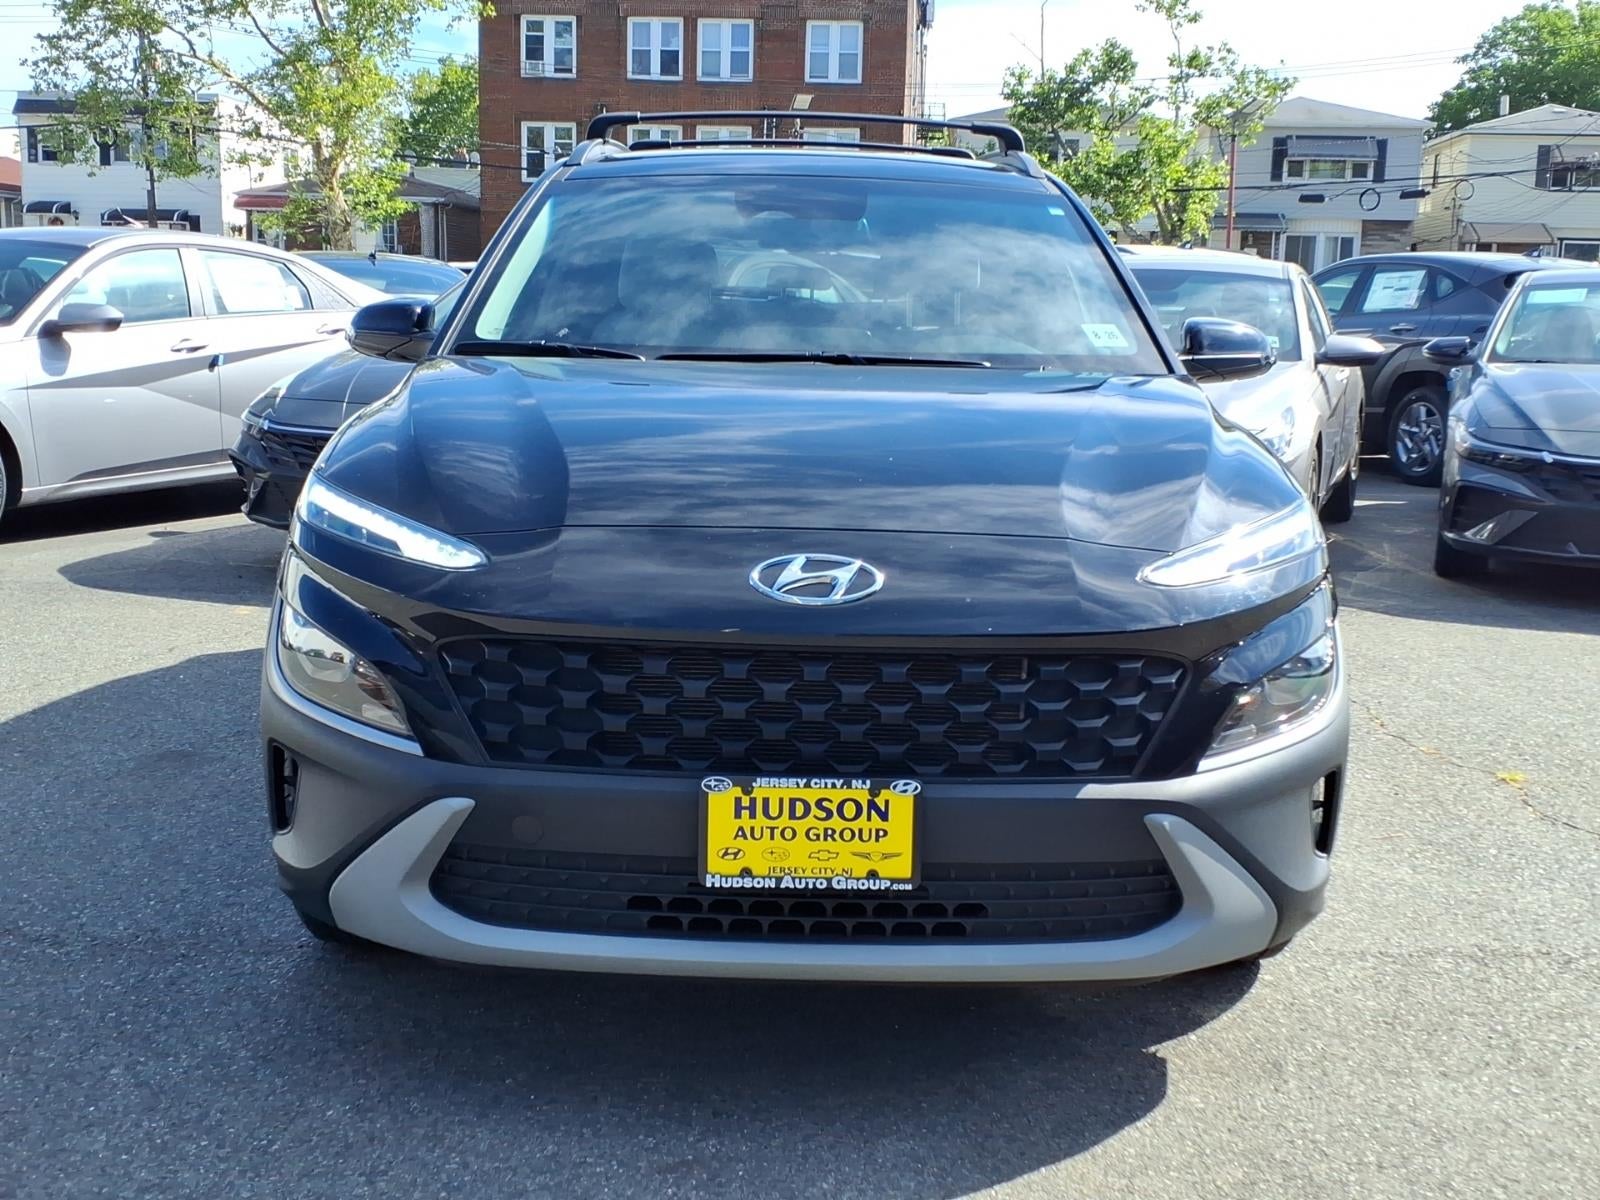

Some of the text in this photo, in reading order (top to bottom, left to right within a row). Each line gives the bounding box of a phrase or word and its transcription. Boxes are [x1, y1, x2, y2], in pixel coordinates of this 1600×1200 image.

[752, 777, 871, 791] JERSEY CITY, NJ
[733, 796, 890, 822] HUDSON
[733, 825, 889, 843] AUTO GROUP
[767, 865, 853, 877] JERSEY CITY, NJ
